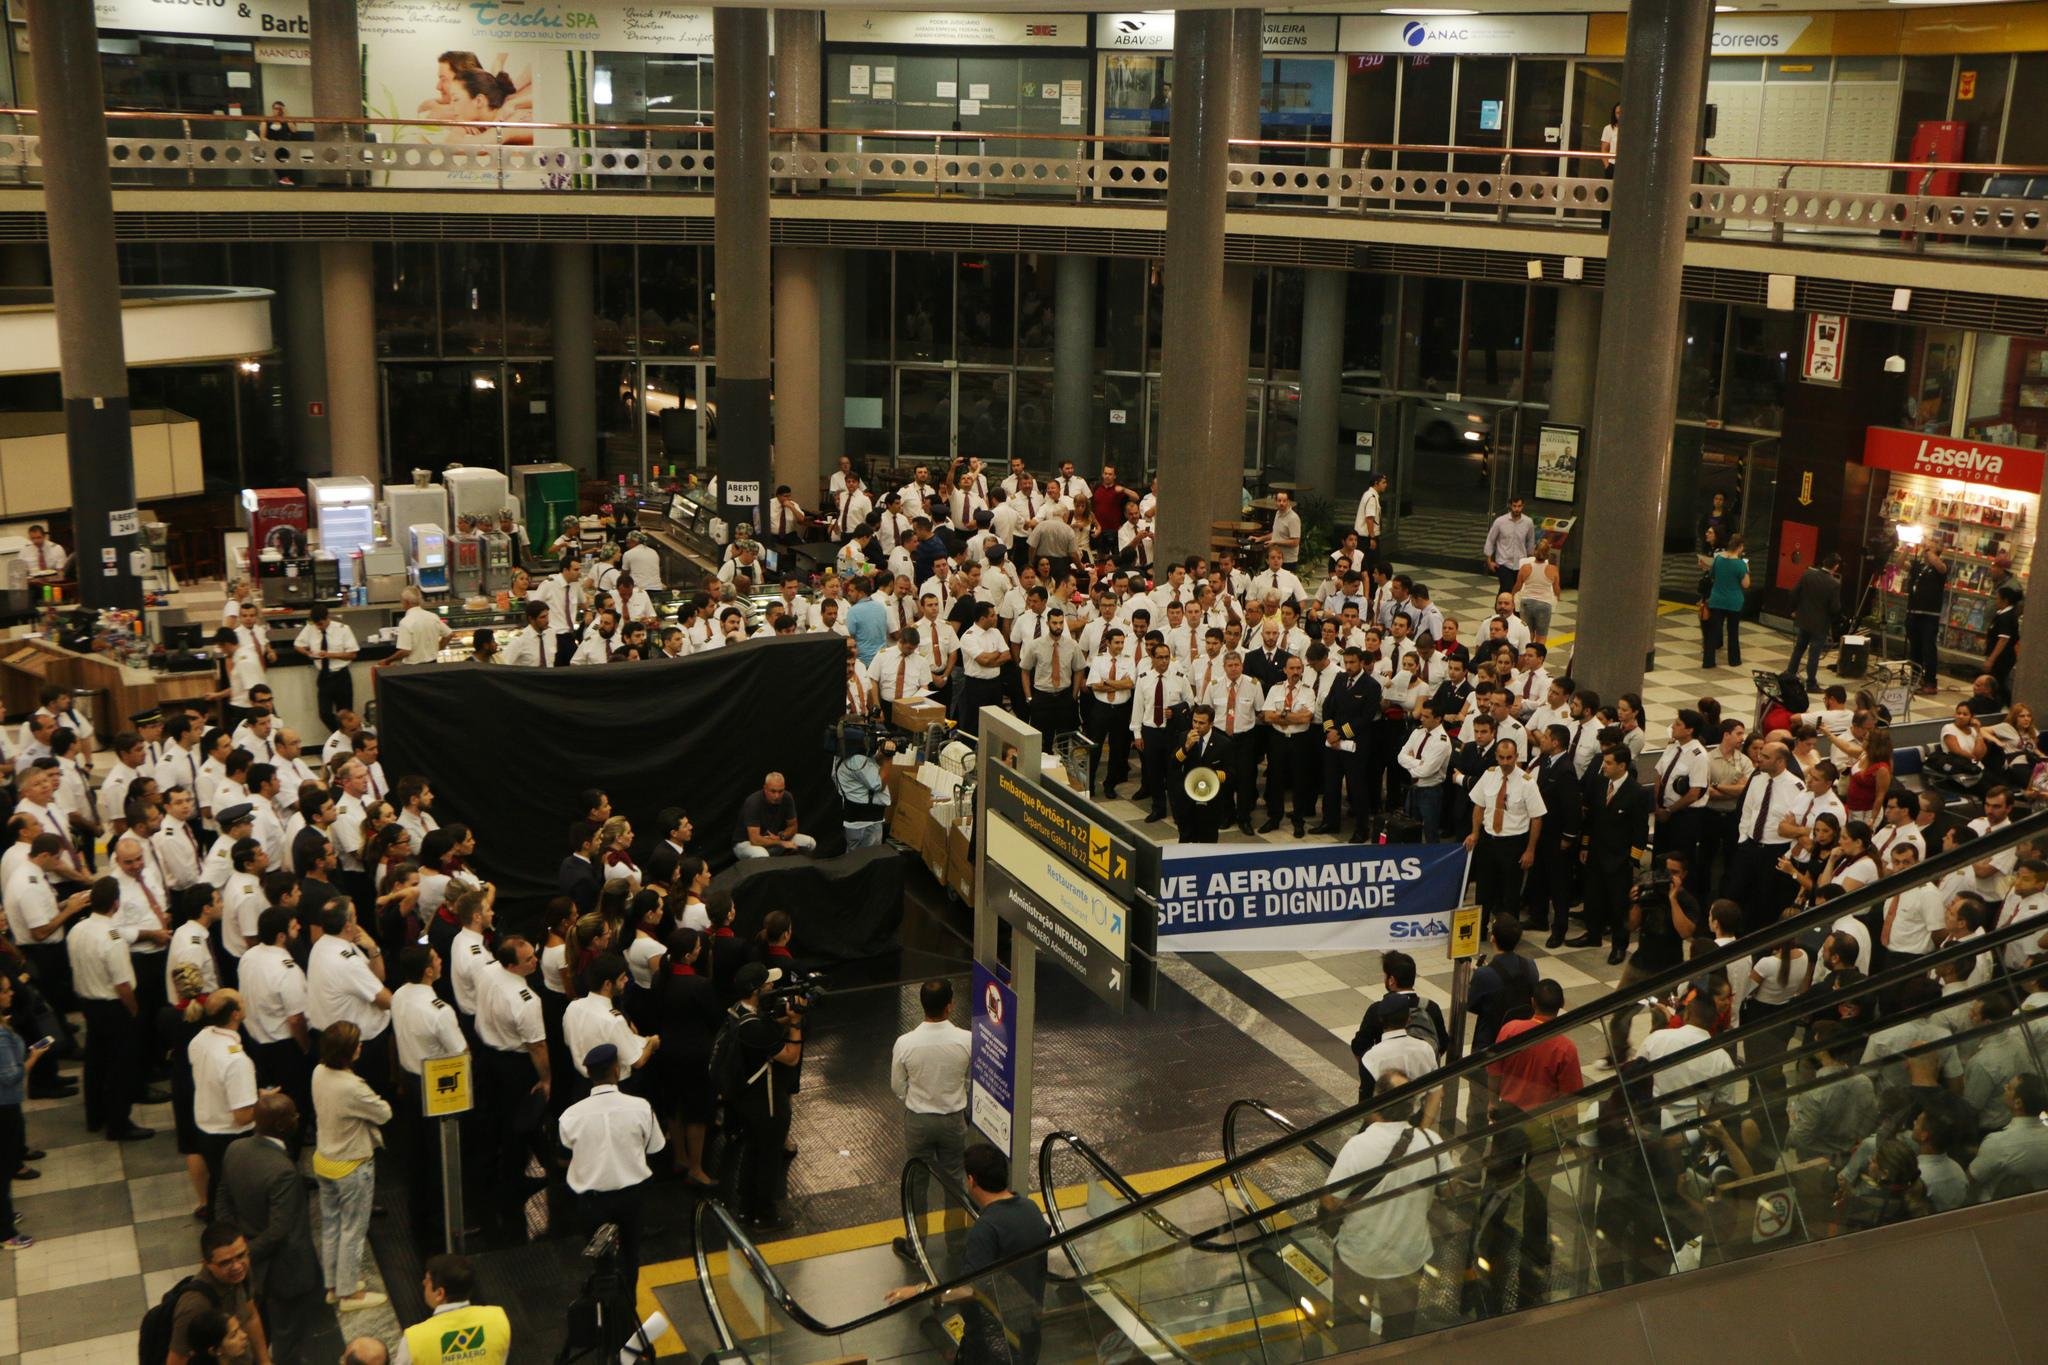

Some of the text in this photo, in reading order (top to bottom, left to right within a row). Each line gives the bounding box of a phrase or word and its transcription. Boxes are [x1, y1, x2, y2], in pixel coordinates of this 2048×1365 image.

[237, 2, 251, 18] &
[566, 12, 599, 28] SPA
[514, 31, 538, 40] para
[555, 31, 578, 39] bem
[1427, 29, 1469, 40] ANAC
[1917, 440, 2004, 474] Laselva
[1914, 462, 2000, 483] BOOKSTORE
[728, 484, 758, 492] ABERTO
[734, 494, 744, 502] 24
[1000, 774, 1035, 808] Embarque
[1036, 799, 1065, 828] Portões
[1078, 827, 1087, 844] 22
[1023, 812, 1051, 838] Departure
[1051, 831, 1067, 851] Gates
[1077, 852, 1087, 864] 22
[1047, 864, 1089, 903] Restaurante
[1206, 857, 1422, 897] AERONAUTAS
[1243, 895, 1258, 918] E
[1264, 884, 1396, 917] DIGNIDADE
[1008, 888, 1088, 957] Administração INFRAERO
[1026, 921, 1087, 976] INFRAERO Administration
[441, 1348, 487, 1362] INFRAERO
